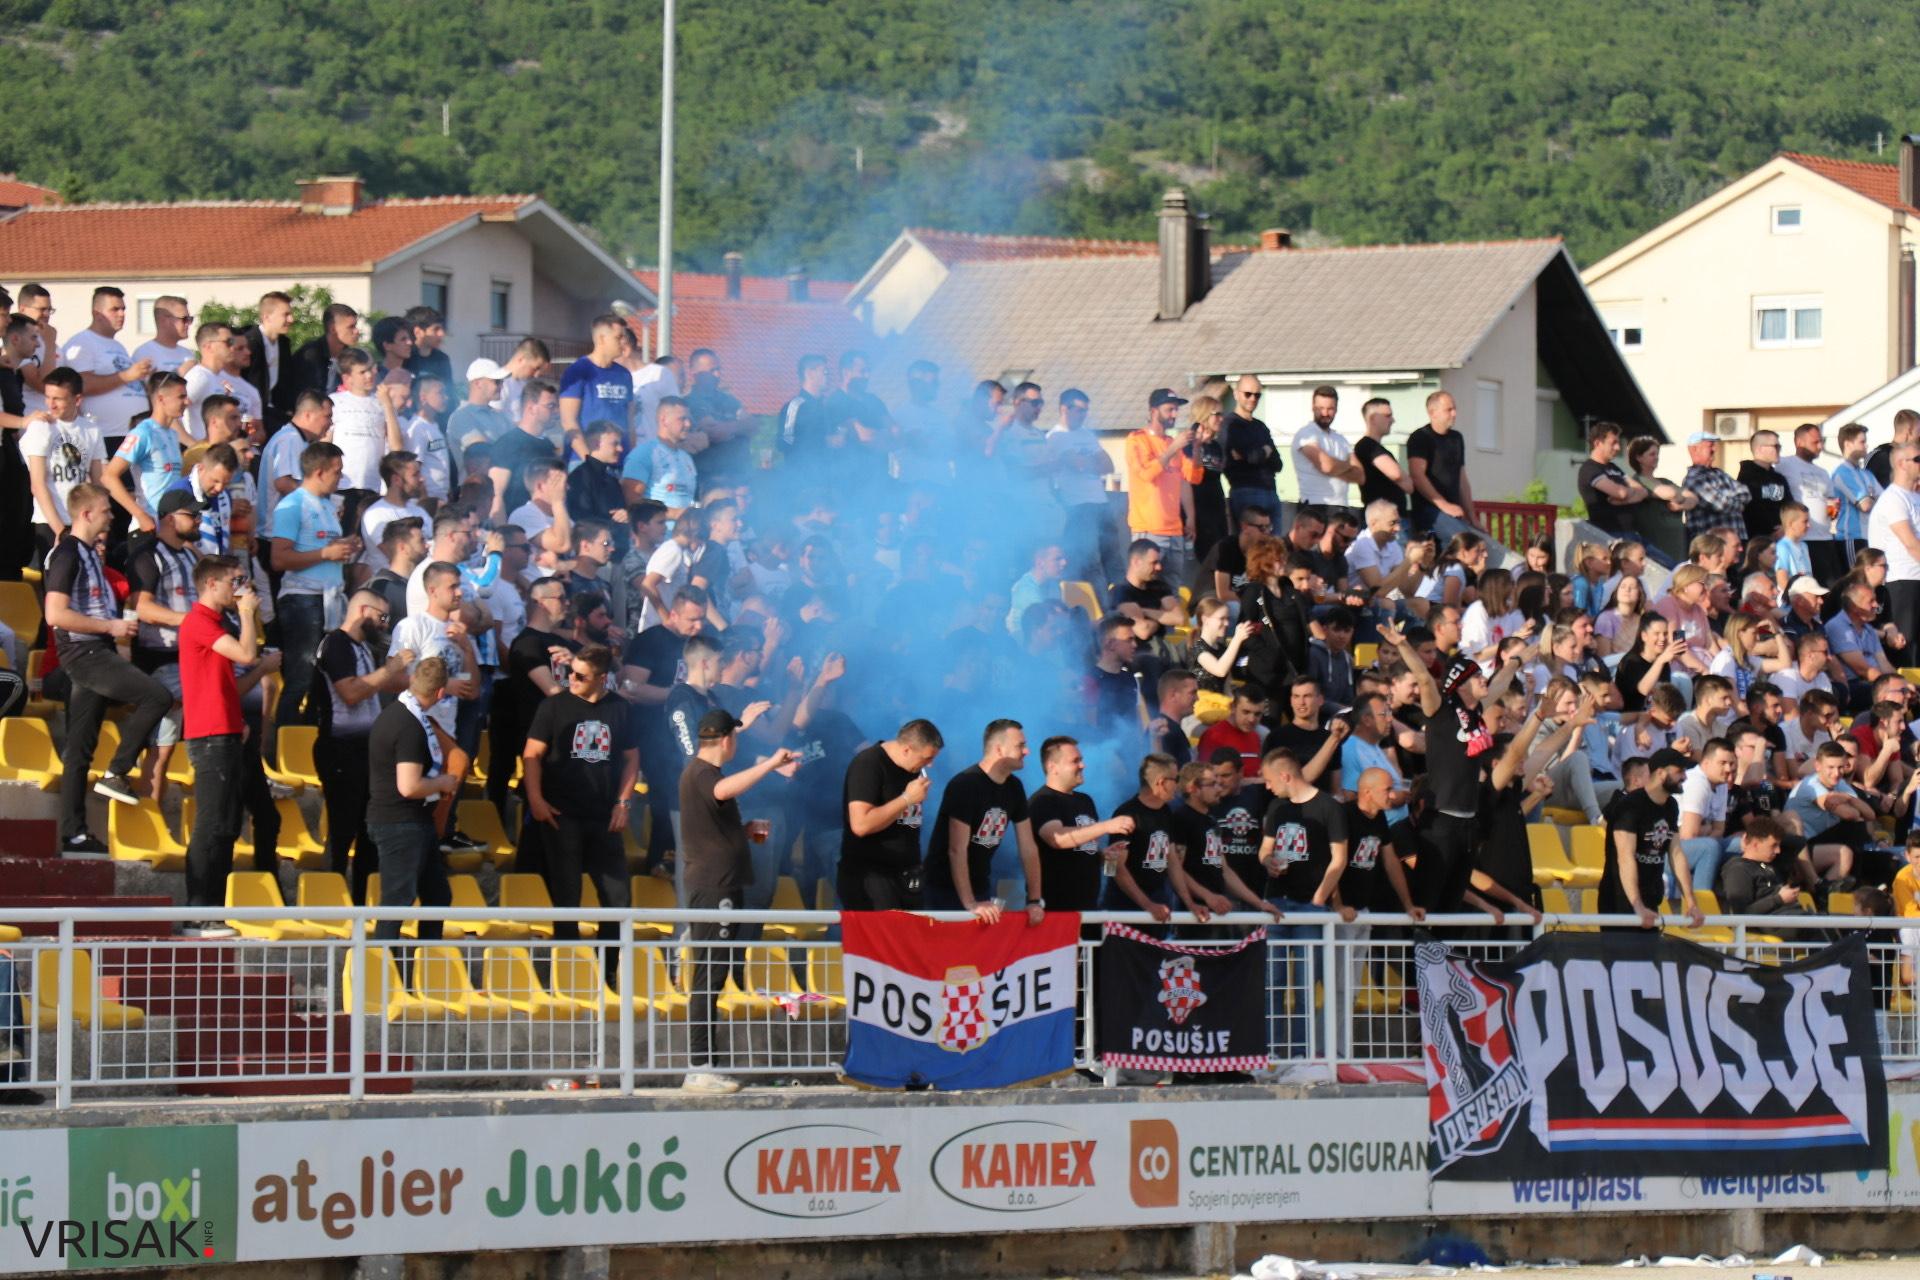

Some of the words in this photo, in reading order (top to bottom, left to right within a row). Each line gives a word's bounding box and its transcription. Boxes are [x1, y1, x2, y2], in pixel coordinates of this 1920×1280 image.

[1131, 1025, 1231, 1054] POSUŠJE
[757, 1145, 901, 1195] KAMEX
[961, 1140, 1097, 1189] KAMEX
[1189, 1142, 1301, 1178] CENTRAL
[107, 1168, 200, 1223] boxi
[253, 1150, 464, 1240] atelier
[485, 1135, 688, 1218] Jukić
[808, 1196, 837, 1212] d.o.o.
[1007, 1190, 1037, 1206] d.o.o.
[1188, 1189, 1231, 1211] Spojeni
[1232, 1187, 1300, 1210] povjerenjem
